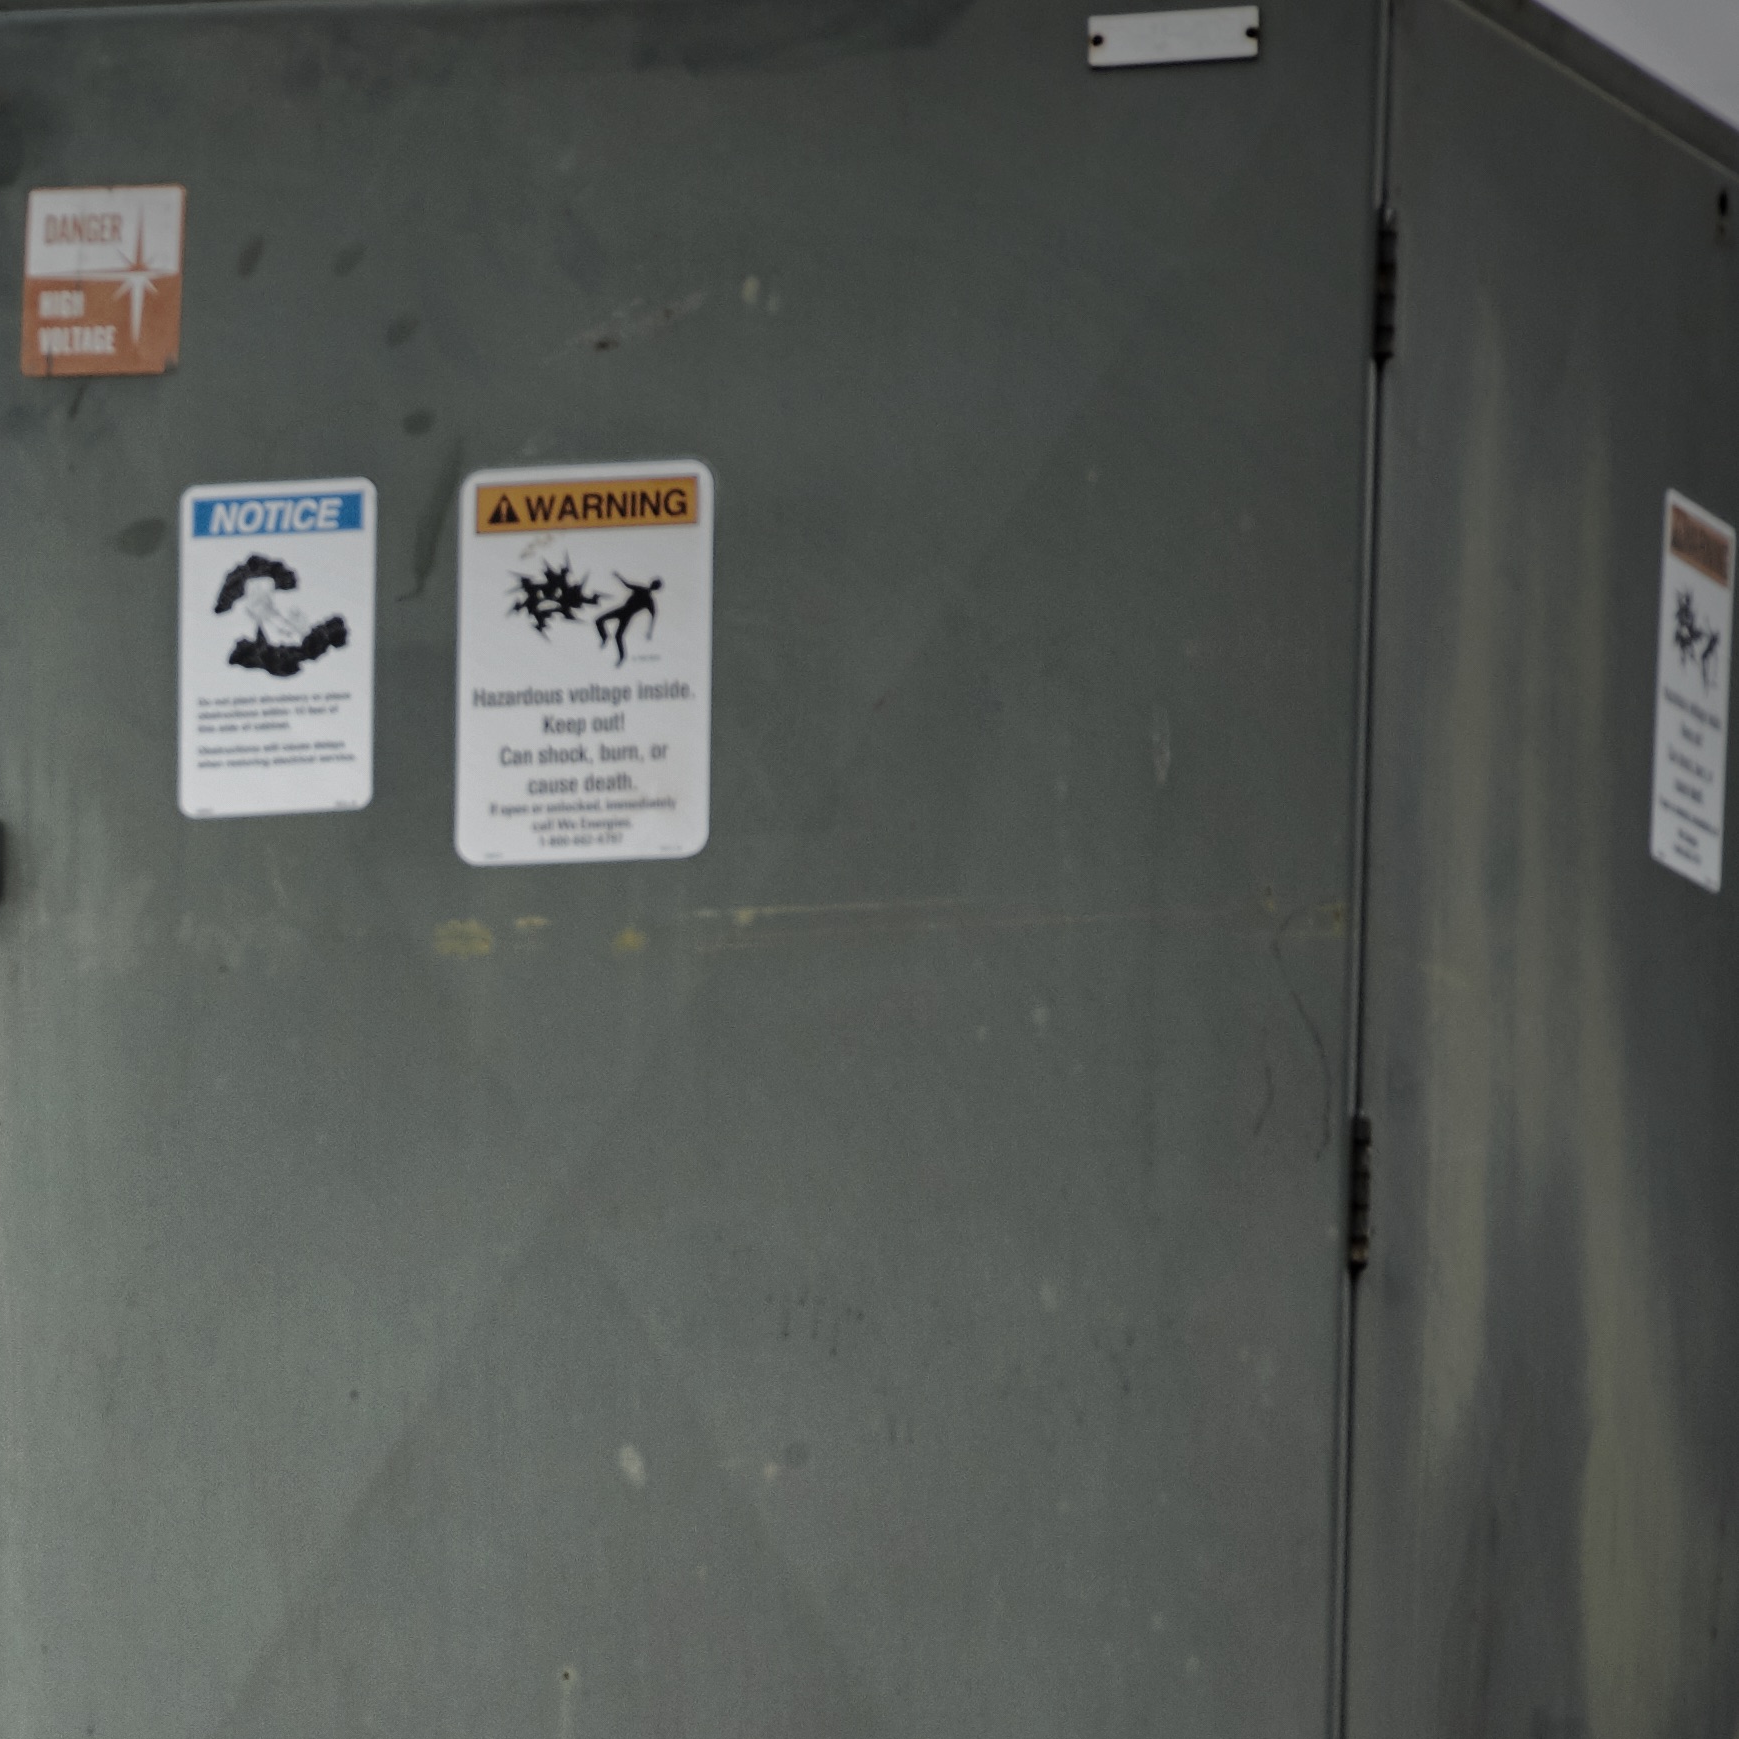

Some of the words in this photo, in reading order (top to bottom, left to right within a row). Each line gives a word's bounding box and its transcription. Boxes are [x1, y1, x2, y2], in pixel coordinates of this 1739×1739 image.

[45, 213, 123, 245] DANGER
[39, 290, 85, 319] HIGH
[38, 325, 116, 356] VOLTAGE
[210, 498, 342, 535] NOTICE
[526, 488, 688, 522] WARNING
[473, 686, 563, 707] Hazardous
[569, 684, 631, 705] voltage
[638, 681, 696, 700] inside.
[543, 714, 586, 735] Keep
[592, 713, 625, 733] out!
[500, 745, 532, 767] Can
[539, 744, 593, 764] shock,
[600, 743, 644, 762] burn,
[651, 743, 668, 759] or
[527, 776, 578, 795] cause
[584, 772, 638, 791] death.
